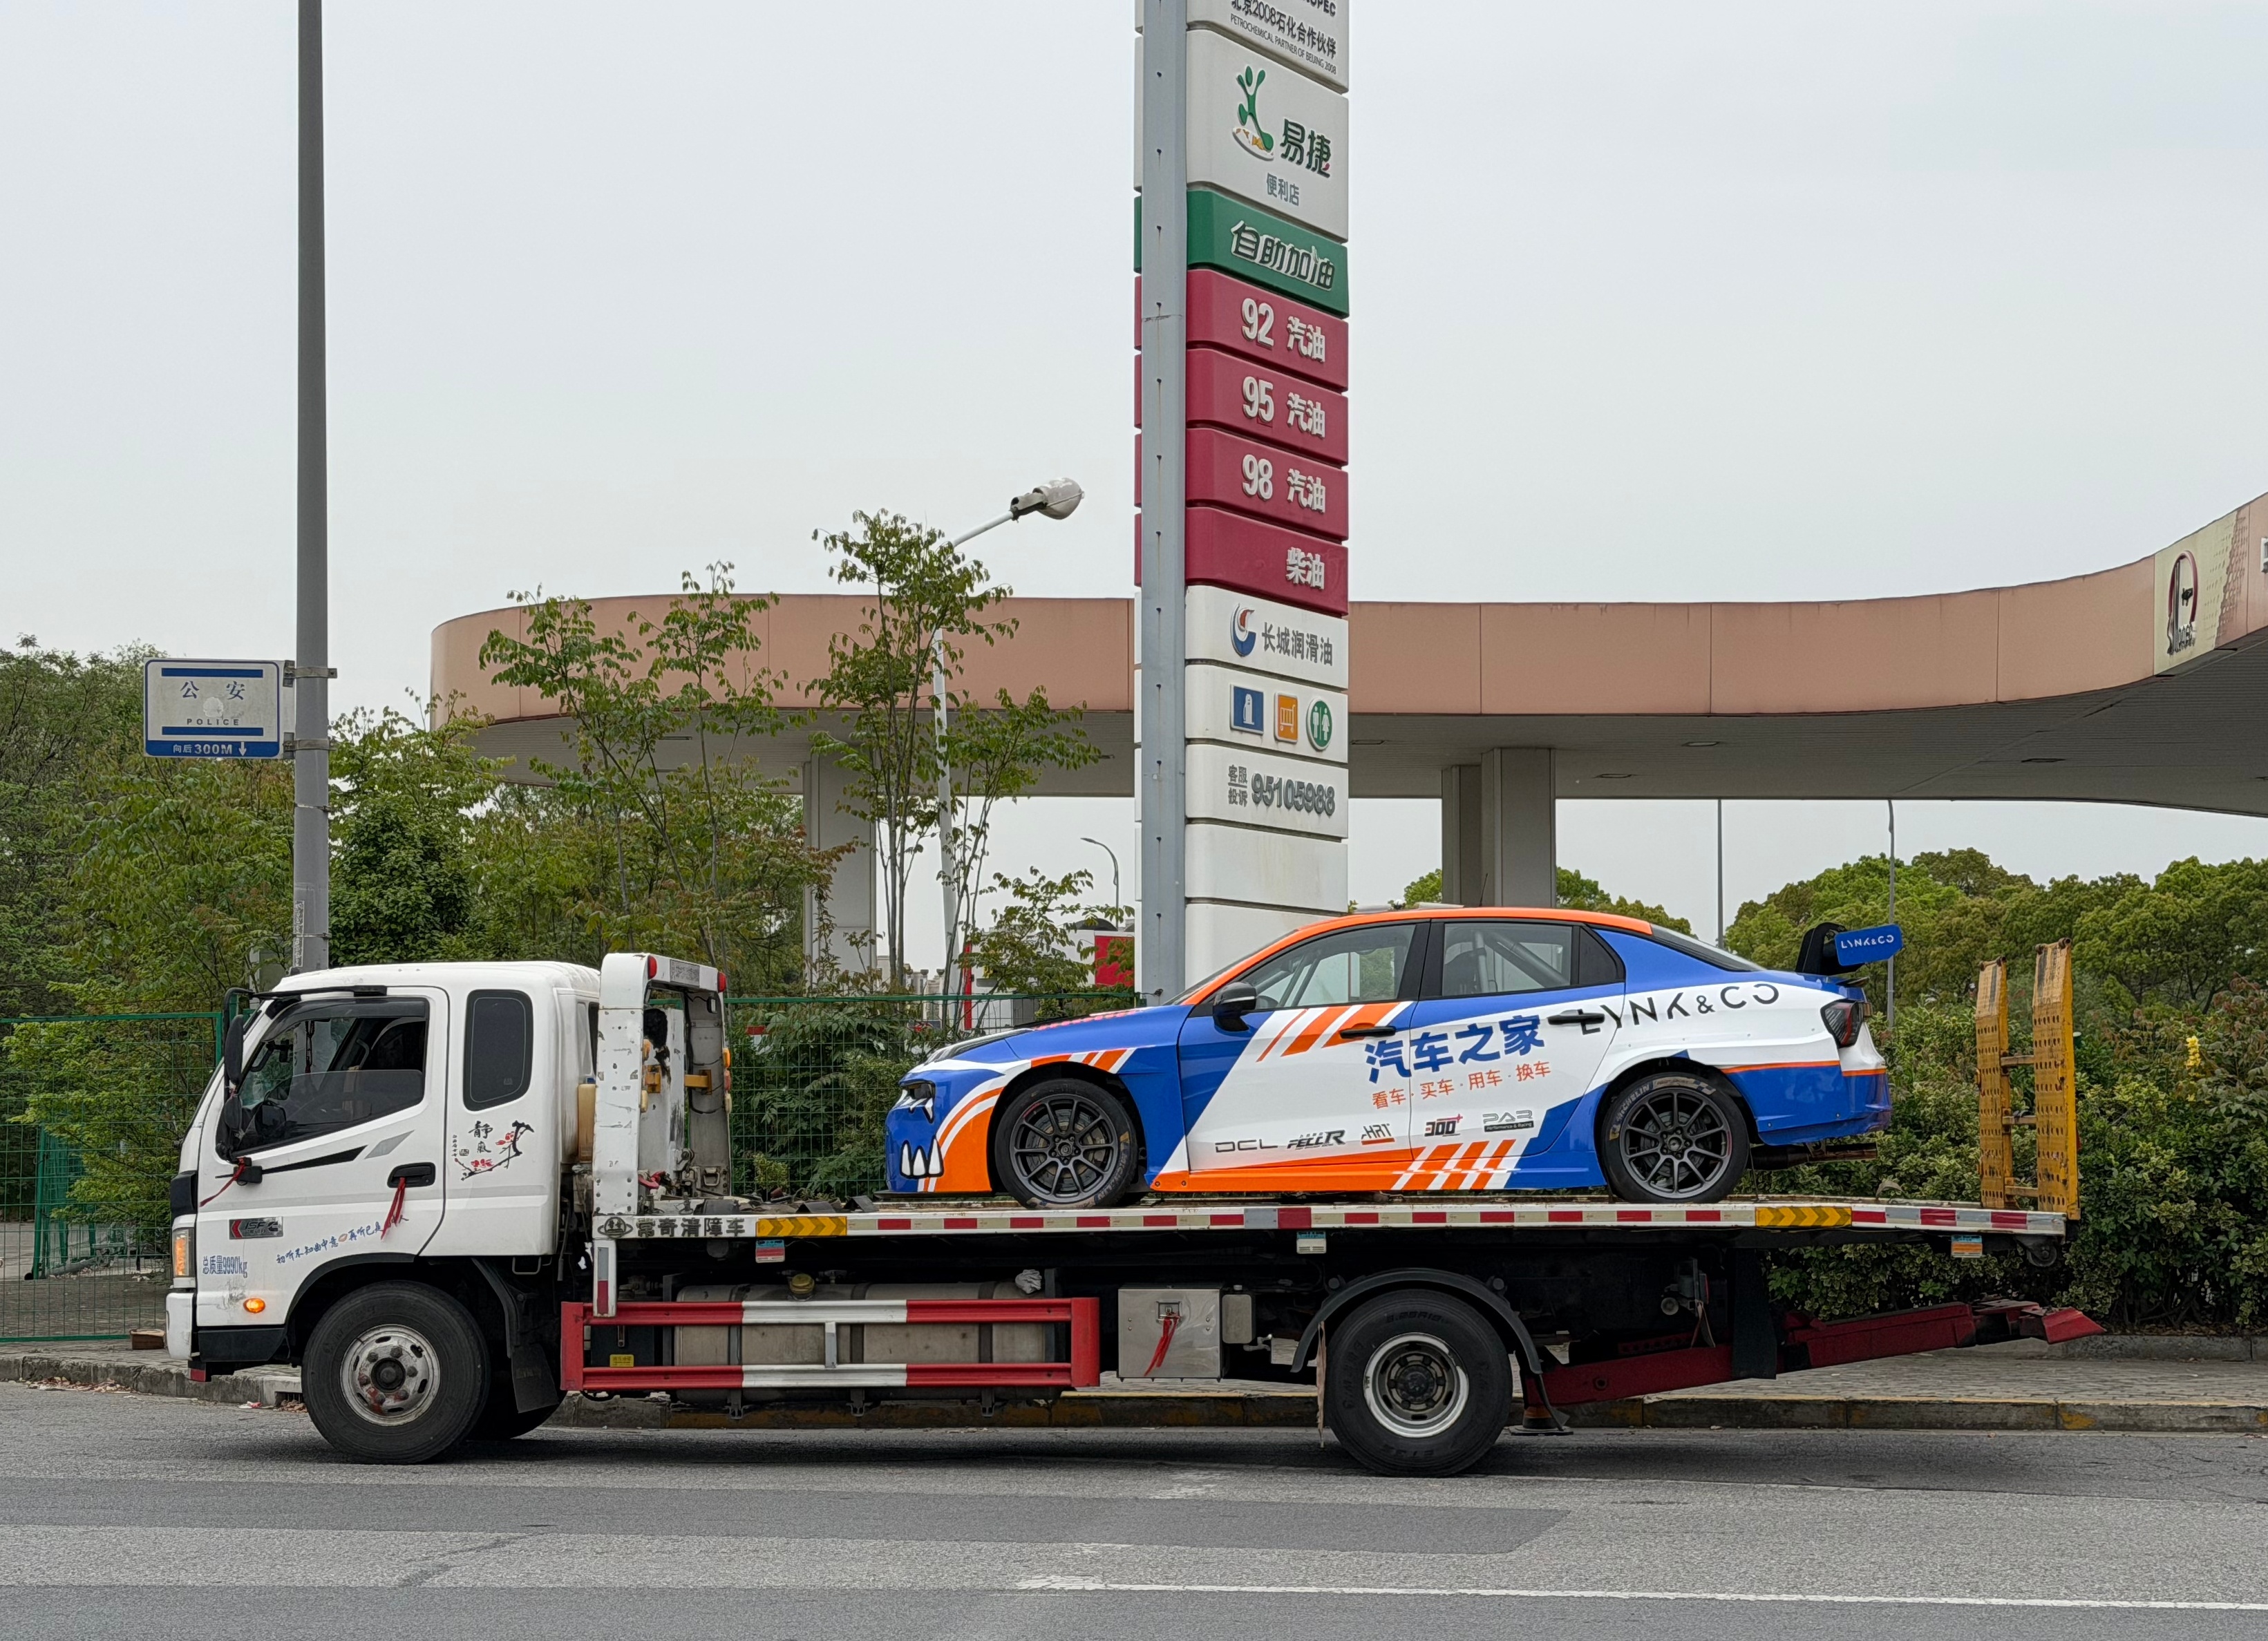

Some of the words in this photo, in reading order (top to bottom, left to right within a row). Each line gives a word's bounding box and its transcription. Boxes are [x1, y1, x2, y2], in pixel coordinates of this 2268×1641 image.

[1231, 13, 1274, 43] PETROCHEMICAL
[1275, 36, 1297, 55] PARTNER
[1298, 48, 1305, 57] OF
[1306, 51, 1324, 68] BEIJING
[1325, 61, 1336, 75] 2008
[1281, 118, 1332, 178] 易捷
[1267, 173, 1300, 206] 便利店
[1231, 220, 1335, 292] 自助加油
[1242, 298, 1274, 349] 92
[1287, 316, 1325, 363] 汽油
[1242, 377, 1274, 423] 95
[1287, 392, 1325, 439] 汽油
[1242, 454, 1274, 502] 98
[1287, 468, 1326, 513] 汽油
[1286, 547, 1325, 590] 柴油
[1261, 622, 1334, 667] 长城润滑油
[187, 718, 240, 726] POLICE
[1228, 764, 1248, 784] 客服
[1251, 772, 1336, 817] 95105988
[1228, 787, 1248, 807] 投诉
[1364, 1014, 1545, 1084] 汽车之家
[1482, 1110, 1533, 1124] PAR
[1215, 1139, 1278, 1153] DCL
[245, 1221, 267, 1230] ISF
[202, 1255, 248, 1278] 总质量9990kg
